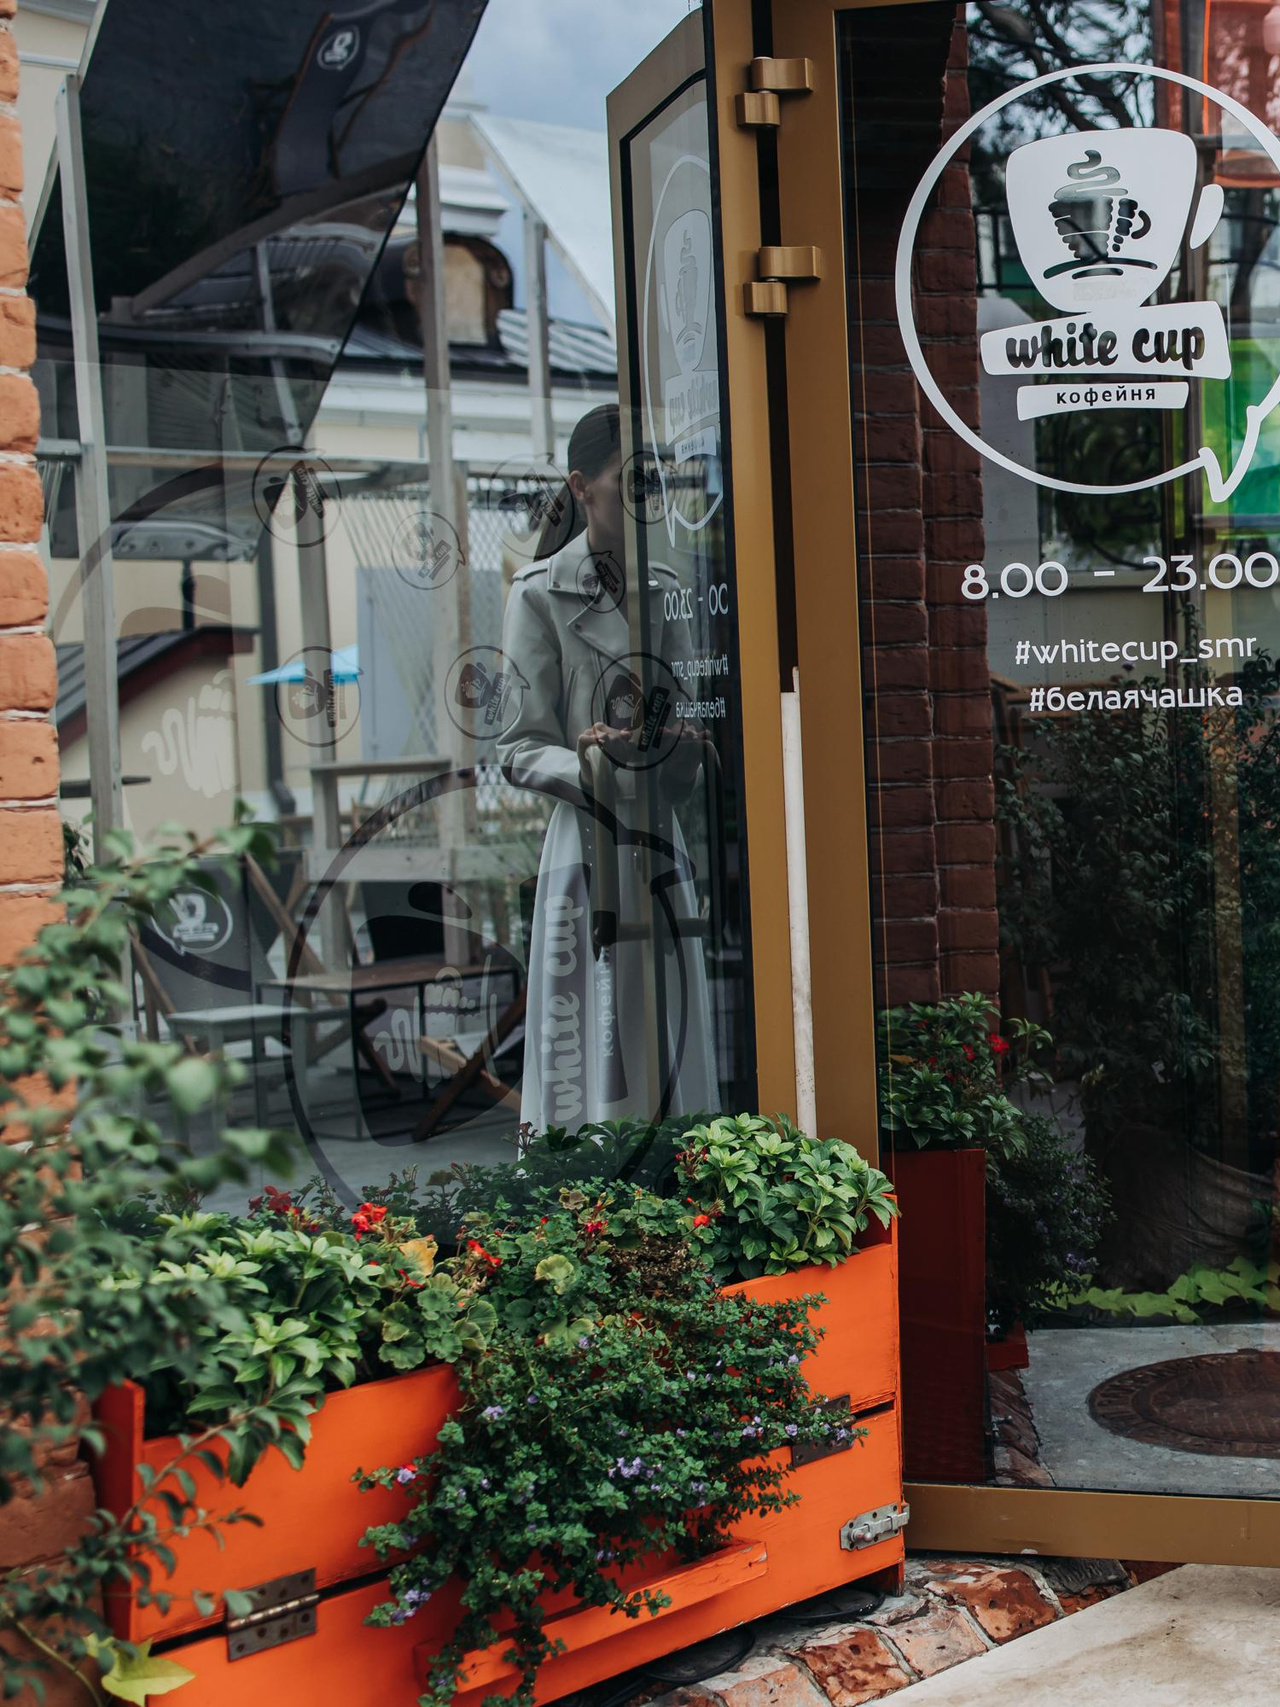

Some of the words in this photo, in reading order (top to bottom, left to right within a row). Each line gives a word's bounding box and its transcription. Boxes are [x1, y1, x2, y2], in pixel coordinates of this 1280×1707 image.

[1005, 322, 1119, 368] white
[1132, 326, 1205, 370] cup
[1056, 385, 1156, 406] кофейня
[961, 561, 1069, 600] 8.00
[1142, 551, 1280, 593] 23.00
[1015, 637, 1257, 669] #whitecup_smr
[1029, 685, 1243, 712] #белаячашка
[544, 895, 585, 977] cup
[540, 991, 583, 1122] white
